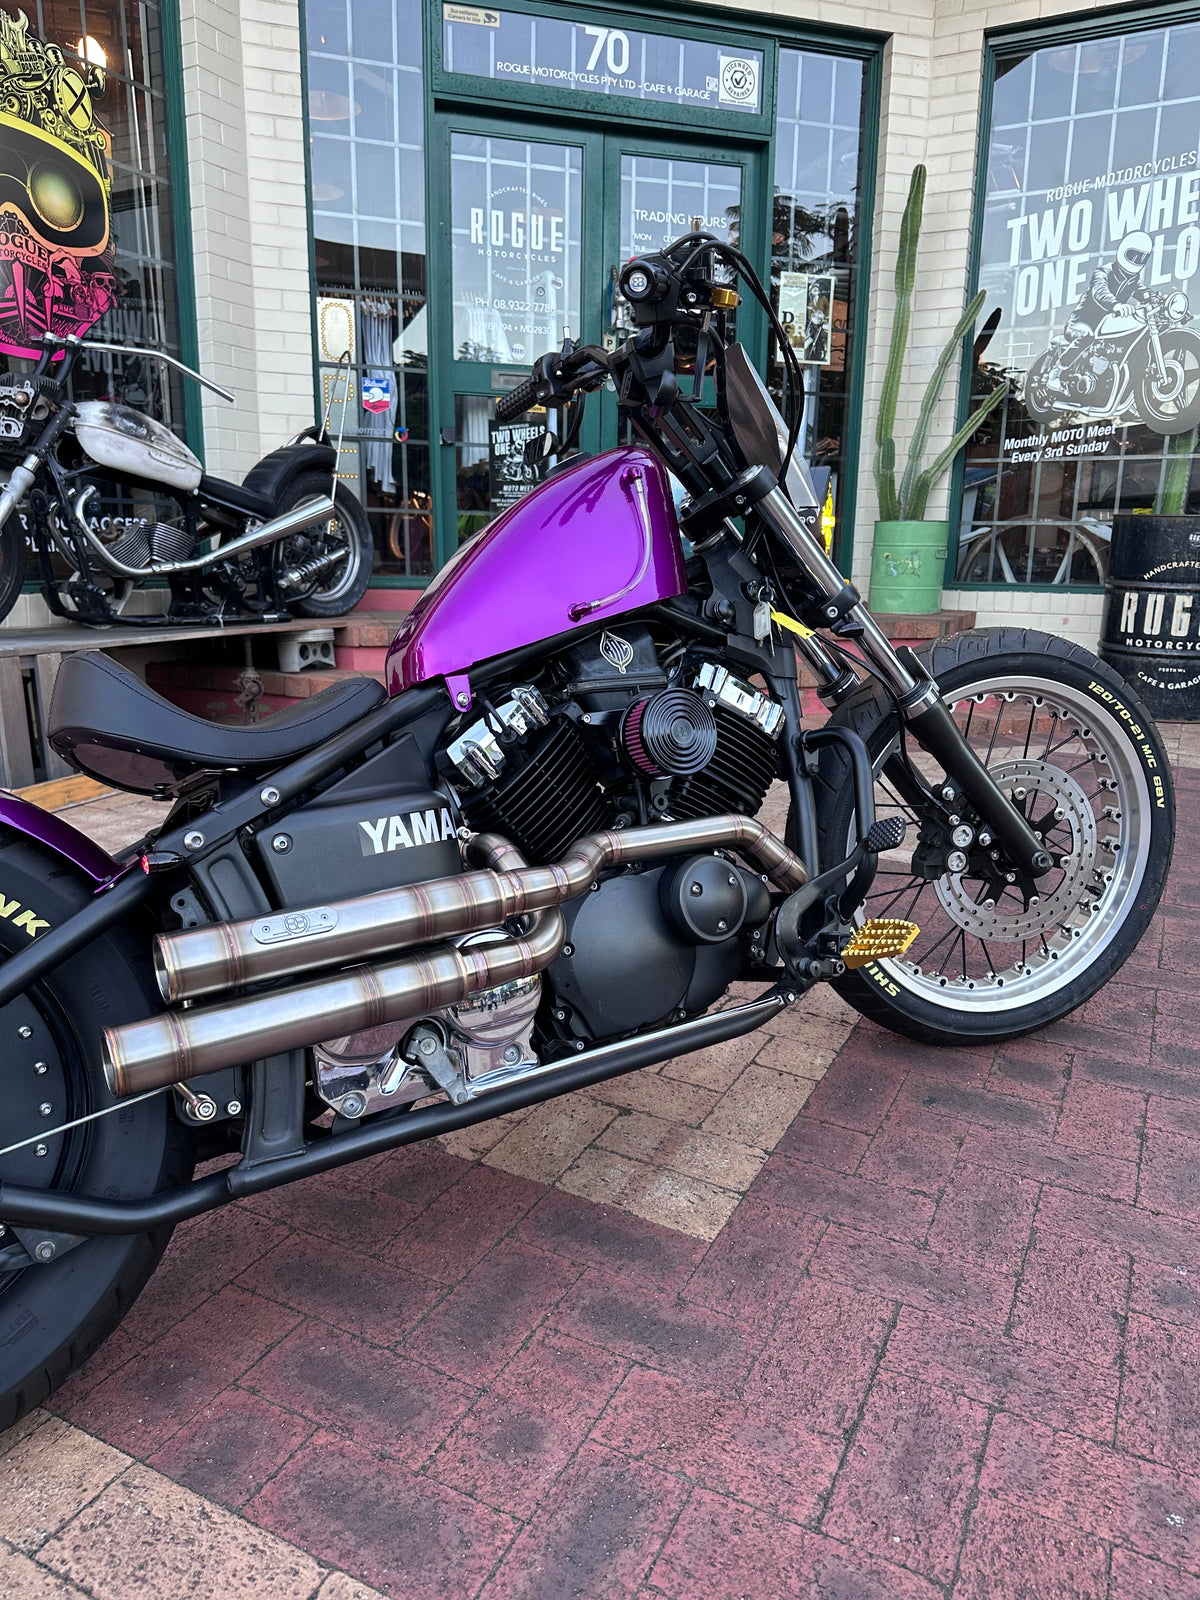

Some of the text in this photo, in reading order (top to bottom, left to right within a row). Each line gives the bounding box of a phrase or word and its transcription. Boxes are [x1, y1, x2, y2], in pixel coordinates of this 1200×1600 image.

[584, 26, 631, 75] 70
[497, 61, 531, 76] ROGUE
[532, 66, 600, 86] MOTORCYCLES
[601, 75, 618, 88] PTY
[619, 77, 636, 90] LTD
[643, 83, 665, 96] CAFE
[674, 86, 711, 100] GARAGE
[726, 62, 752, 76] LICENSED
[727, 86, 751, 97] REPAIRER
[1046, 150, 1198, 203] ROGUE MOTORCYCLES
[470, 206, 563, 253] ROGUE
[634, 209, 728, 229] TRADING HOURS
[633, 232, 652, 241] MON
[1006, 199, 1093, 268] TWO
[478, 248, 557, 264] MOTORCYCLES
[634, 244, 646, 252] TUE
[1016, 252, 1091, 317] ONE
[475, 296, 489, 307] PH
[493, 298, 506, 310] 08
[508, 300, 531, 312] 9322
[490, 430, 511, 444] TWO
[511, 425, 546, 442] WHEELS
[1003, 423, 1117, 452] Monthly MOTO Meet
[494, 442, 511, 456] ONE
[1011, 439, 1110, 464] Every 3rd Sunday
[503, 484, 519, 492] MOTO
[1120, 591, 1200, 637] ROG
[1137, 671, 1157, 687] CAFE
[1087, 681, 1146, 741] 120/70-21
[1141, 744, 1158, 769] M/C
[358, 807, 457, 855] YAMA
